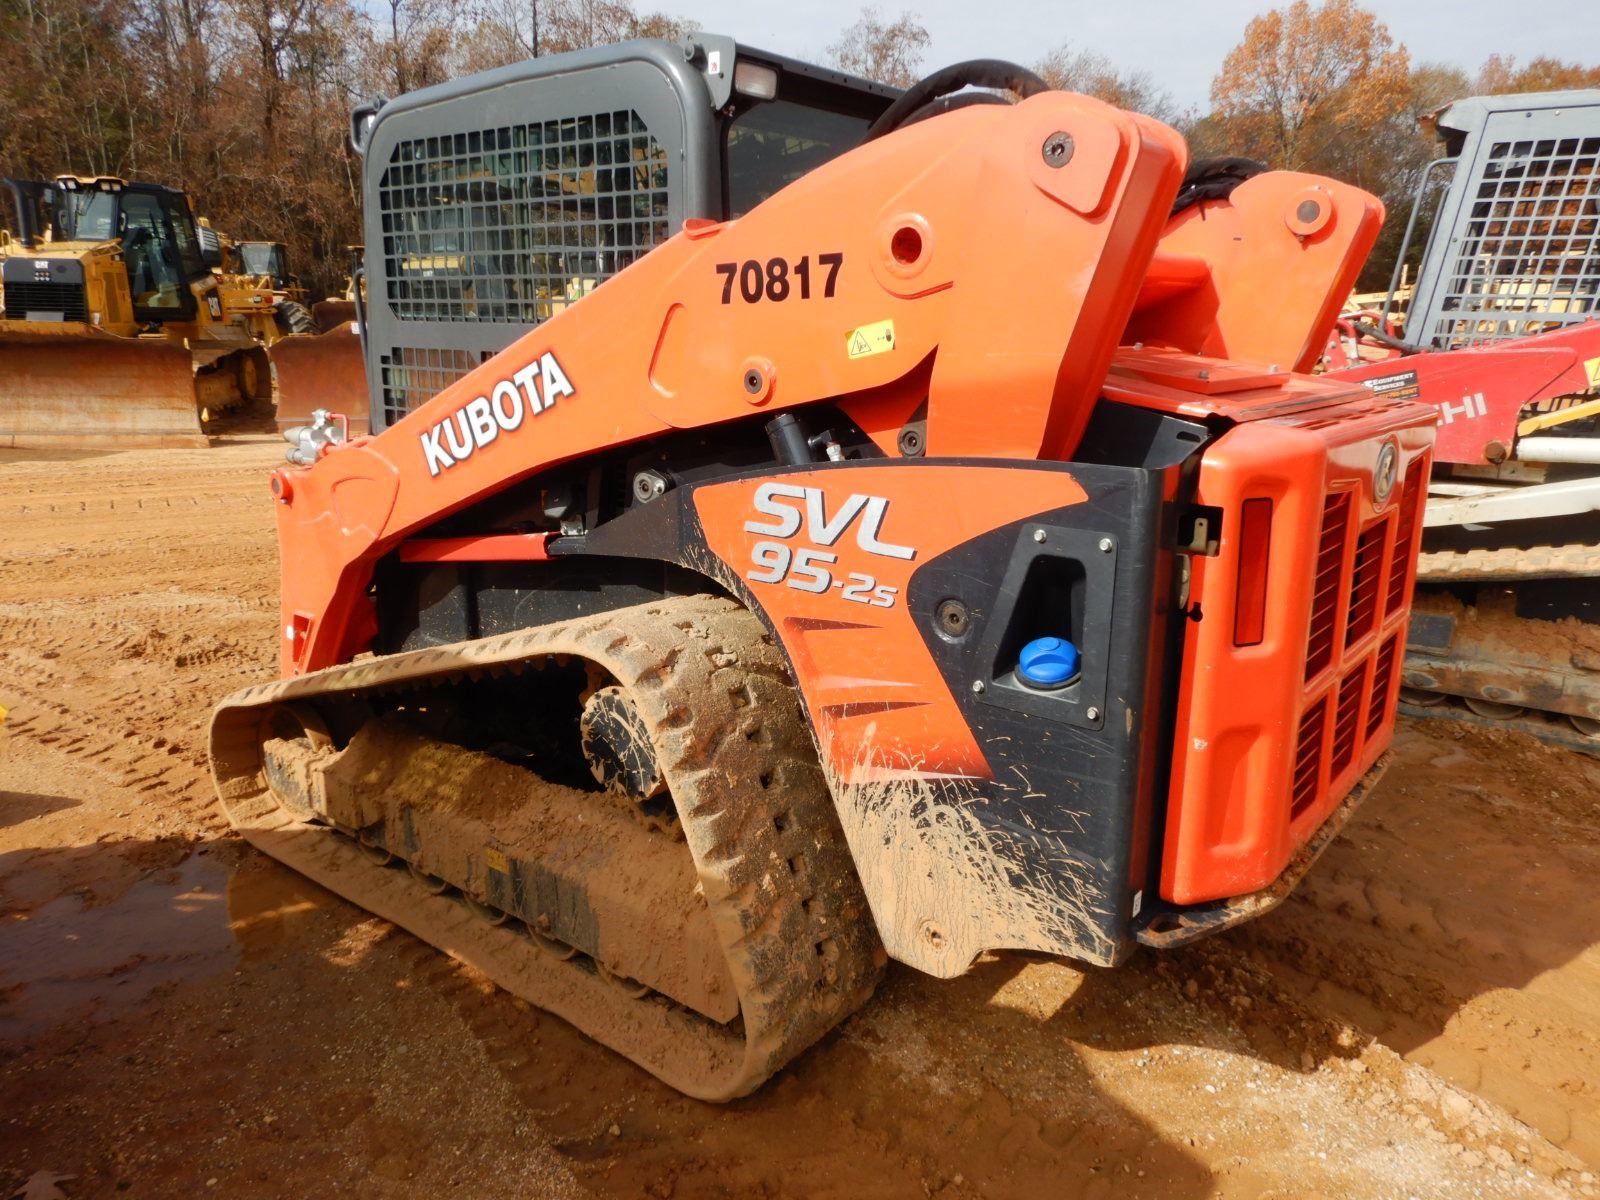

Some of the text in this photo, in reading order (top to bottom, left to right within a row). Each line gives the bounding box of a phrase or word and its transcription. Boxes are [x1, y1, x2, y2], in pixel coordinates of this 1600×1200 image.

[208, 296, 221, 317] CAT
[716, 252, 843, 305] 70817
[420, 351, 575, 477] KUBOTA
[743, 482, 918, 562] SVL
